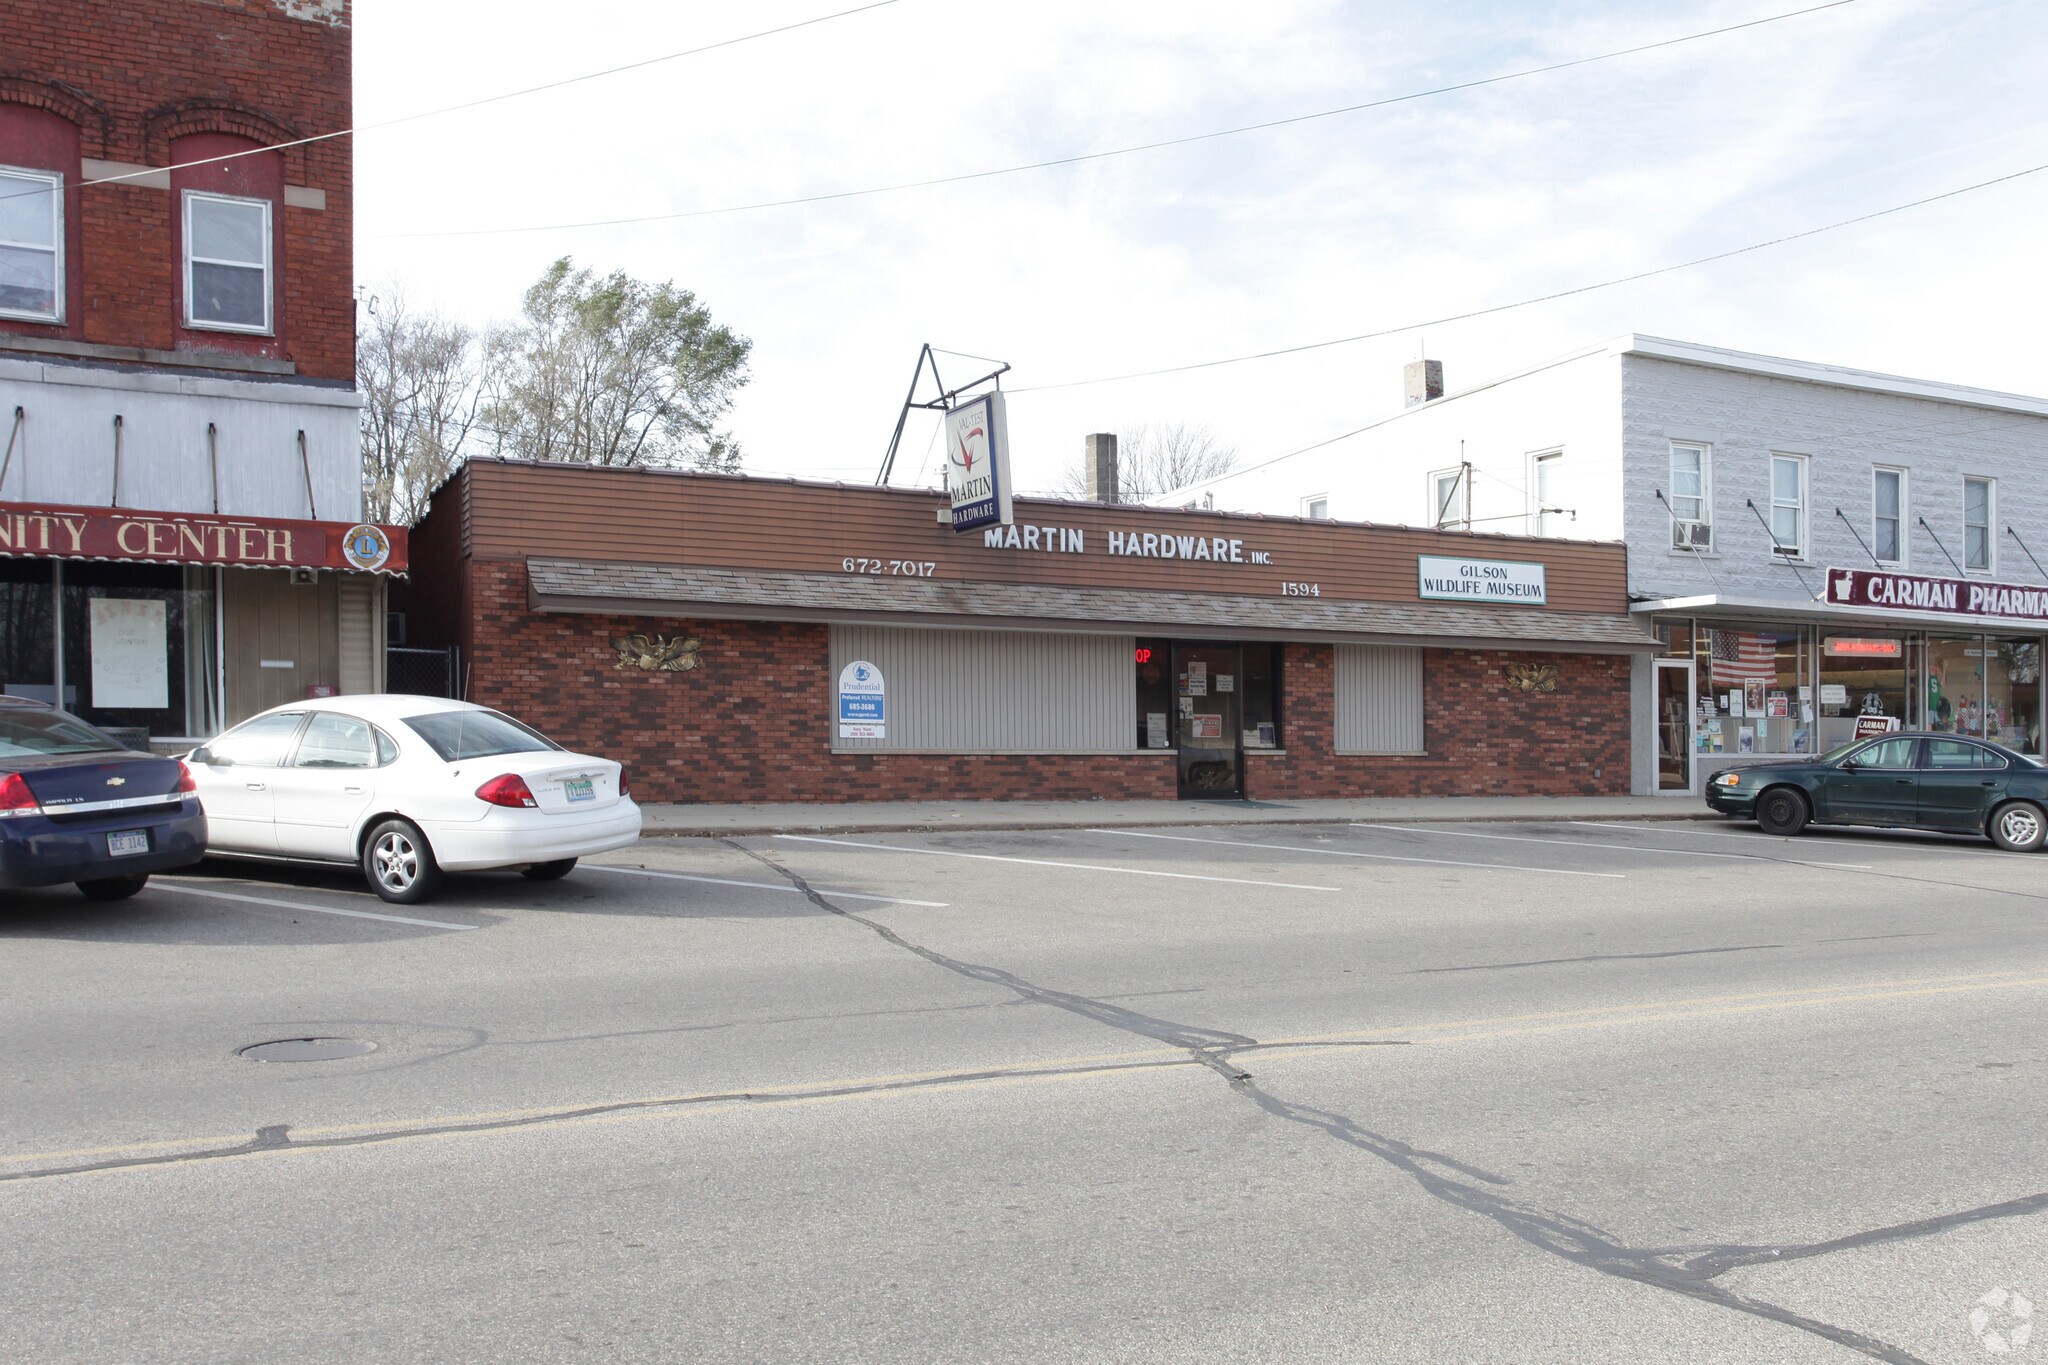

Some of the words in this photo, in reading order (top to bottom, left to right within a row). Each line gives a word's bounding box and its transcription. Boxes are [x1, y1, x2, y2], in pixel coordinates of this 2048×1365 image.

[958, 411, 984, 430] VAL-TEST
[952, 475, 991, 503] MARTIN
[953, 502, 994, 524] HARDWARE
[117, 521, 294, 562] CENTER
[361, 538, 372, 554] L
[984, 525, 1084, 553] MARTIN
[1251, 552, 1273, 564] INC.
[1460, 565, 1508, 580] GILSON
[1281, 582, 1321, 597] 1594
[1424, 578, 1481, 594] WILDLIFE
[1486, 582, 1542, 597] MUSEUM
[1867, 577, 1957, 608] CARMAN
[843, 682, 881, 691] Prudential
[1859, 720, 1886, 730] CARMAN
[128, 836, 146, 849] 1142
